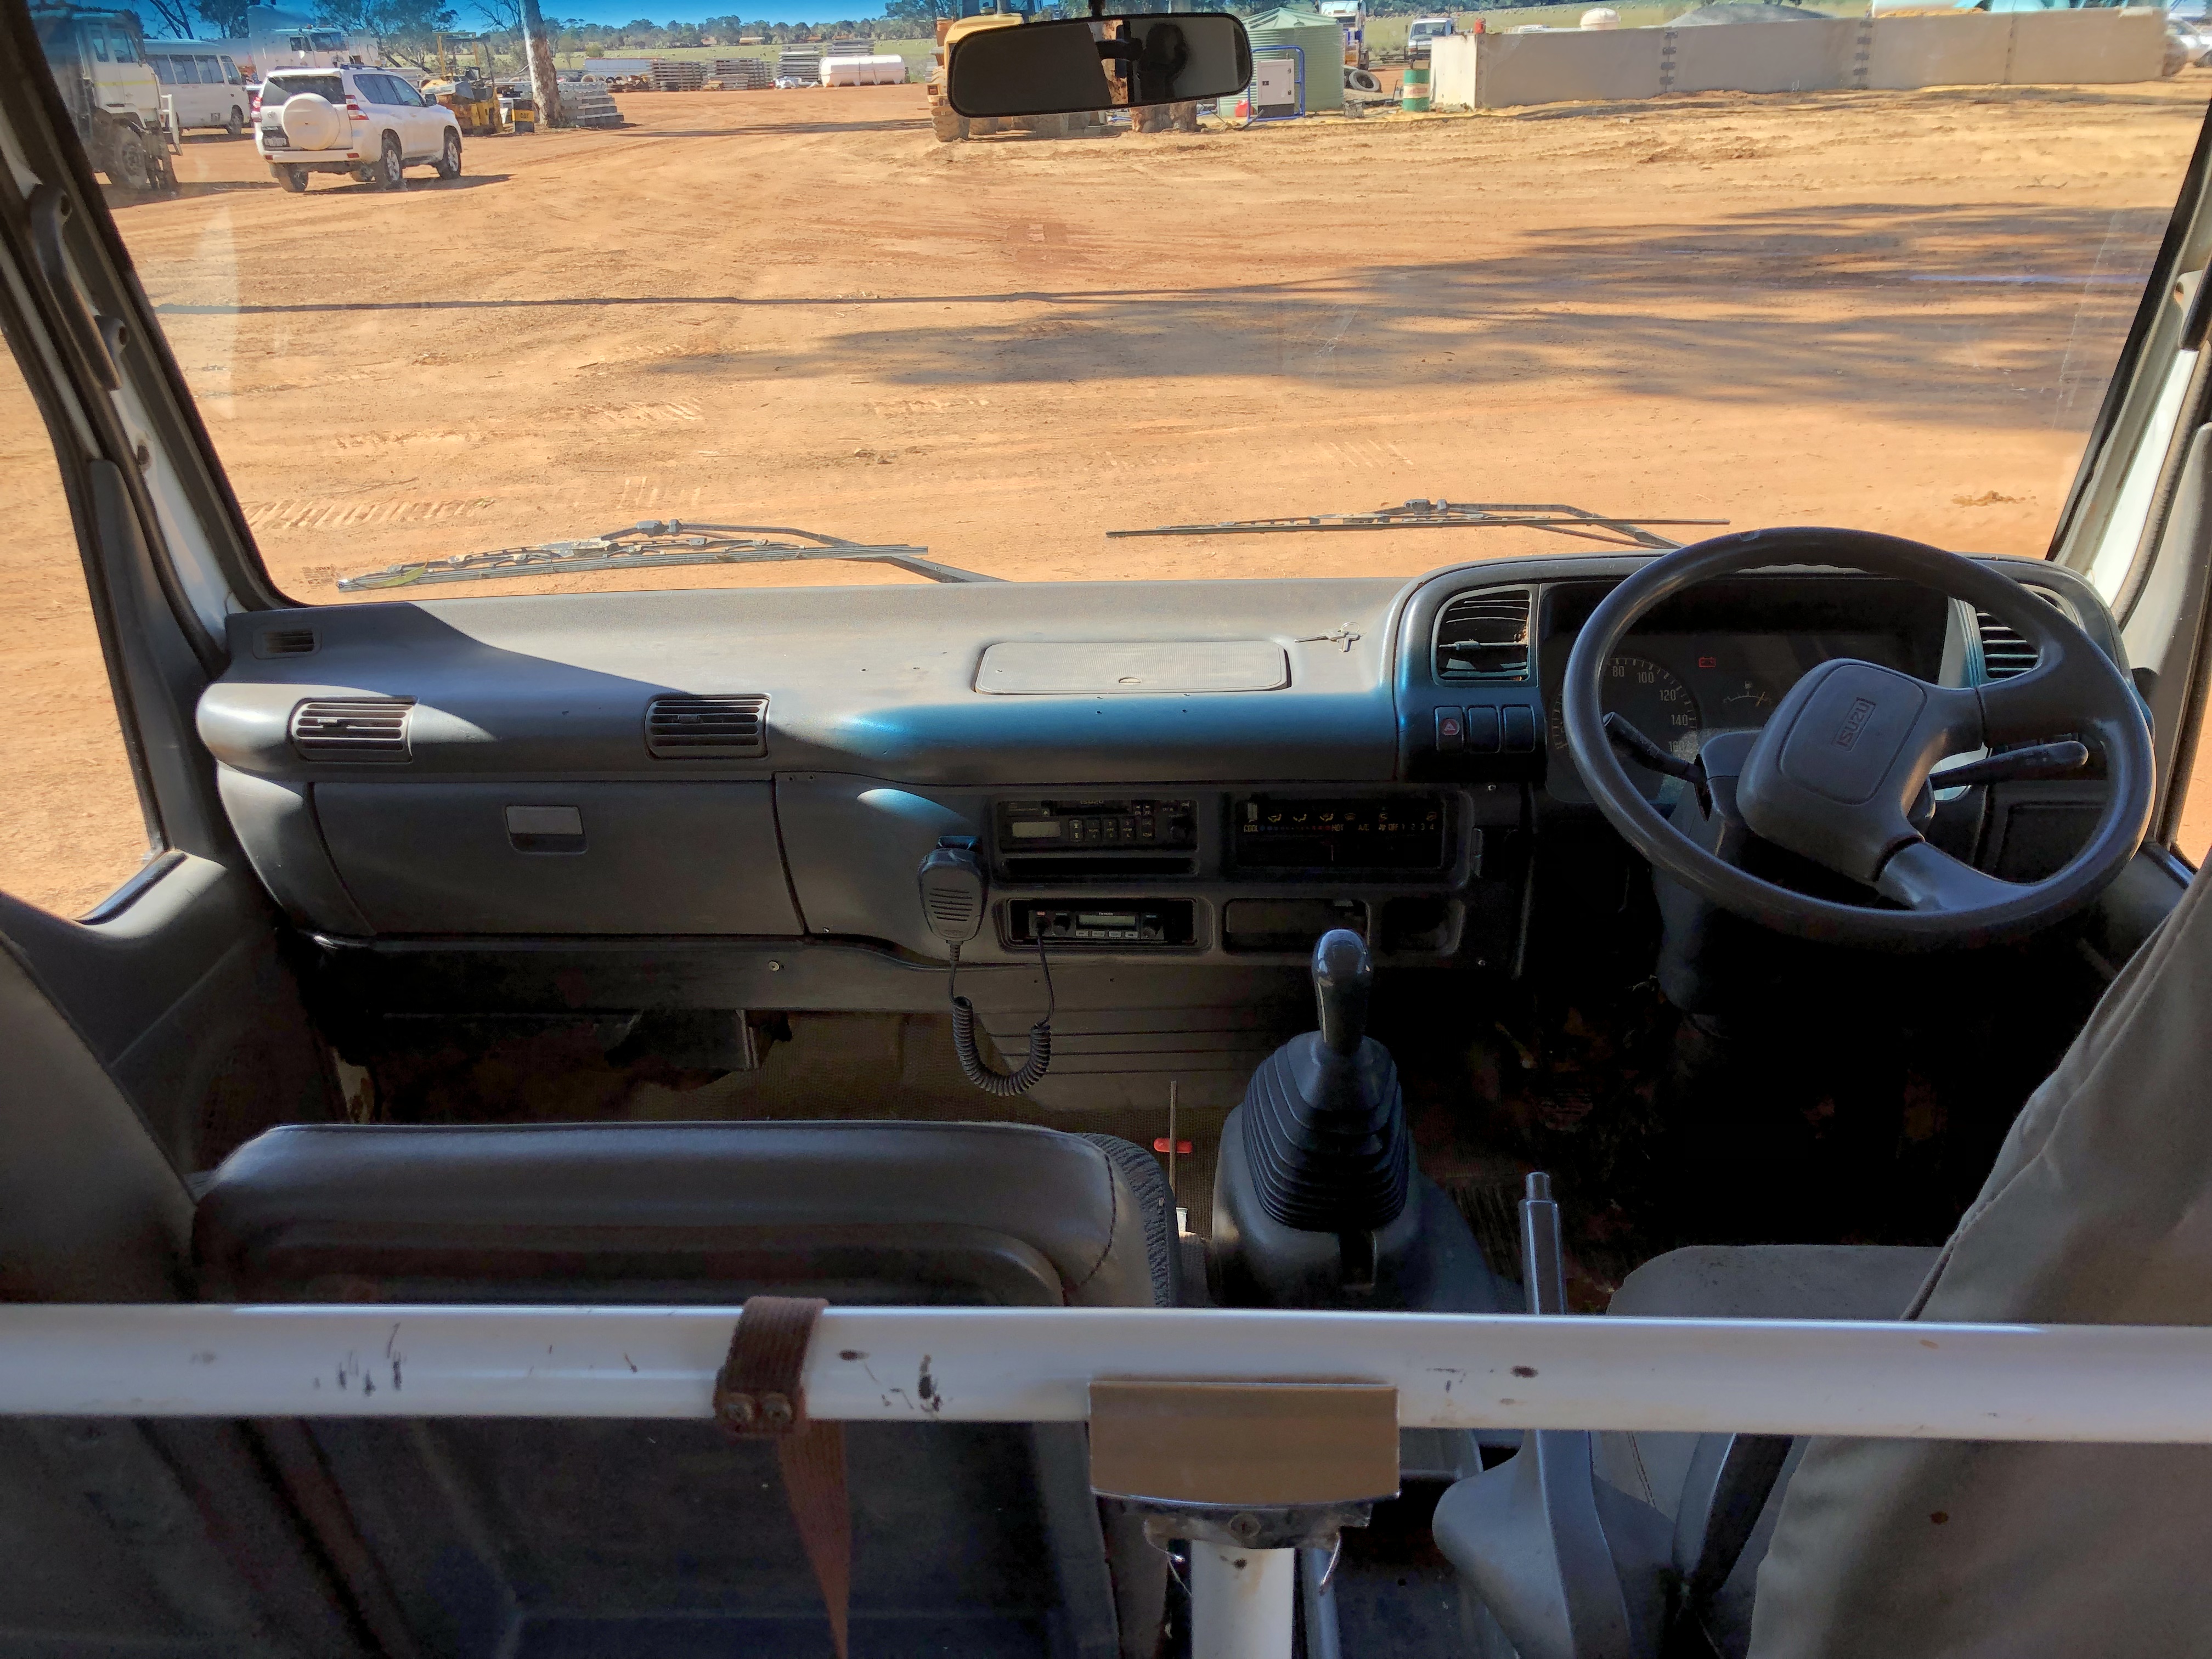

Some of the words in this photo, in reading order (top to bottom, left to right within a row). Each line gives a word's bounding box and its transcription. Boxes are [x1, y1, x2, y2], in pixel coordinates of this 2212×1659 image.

[1612, 665, 1624, 678] 80
[1637, 672, 1654, 684] 100
[1659, 689, 1677, 702] 120
[1671, 714, 1689, 726] 140
[1836, 702, 1871, 747] ISUZU
[1244, 824, 1259, 832] COOL
[1332, 823, 1344, 832] HOT
